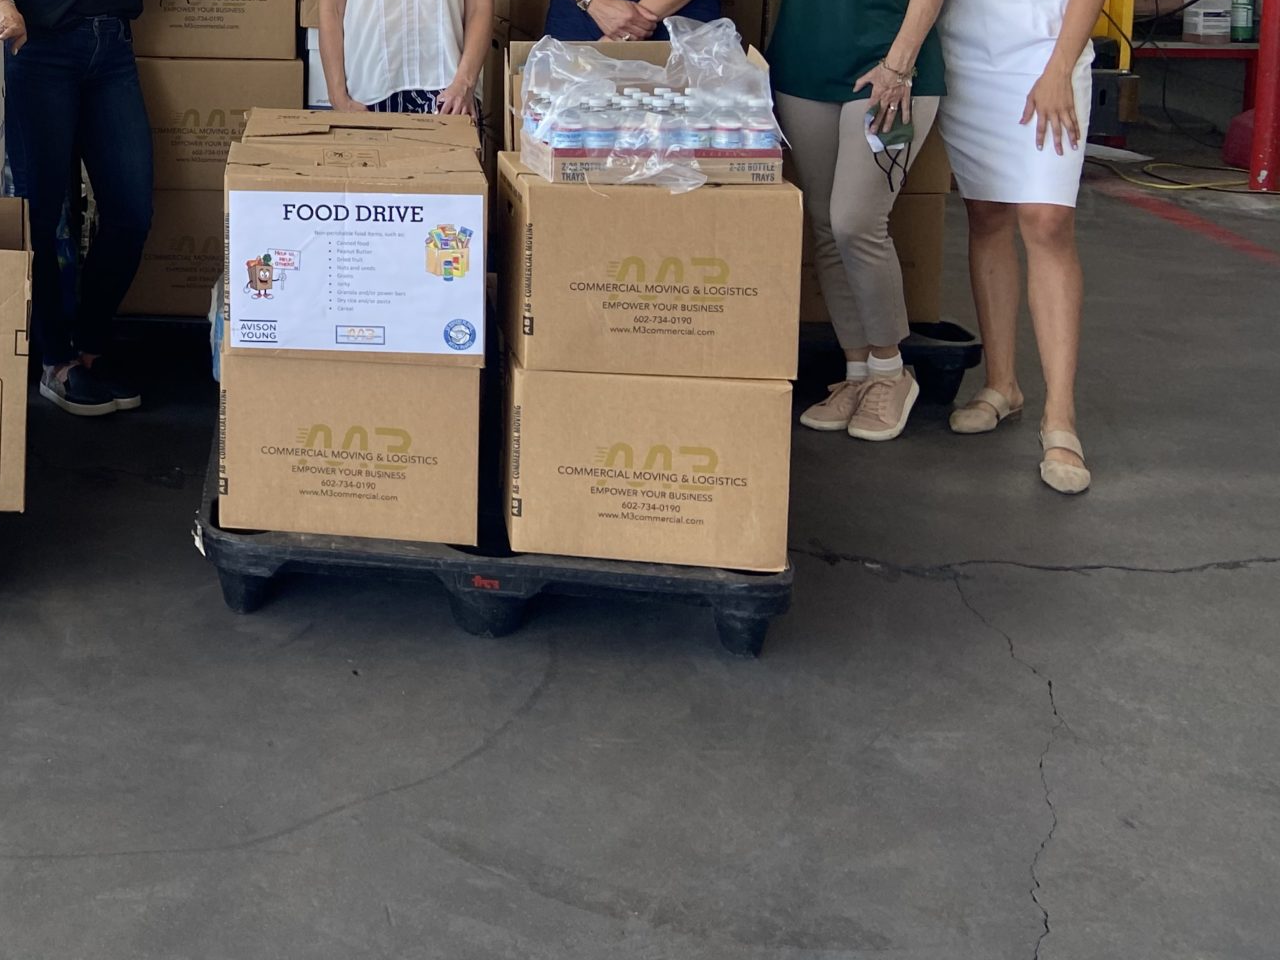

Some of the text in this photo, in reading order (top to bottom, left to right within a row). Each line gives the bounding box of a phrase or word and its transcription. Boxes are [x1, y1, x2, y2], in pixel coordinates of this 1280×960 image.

[748, 162, 775, 172] BOTTLE
[751, 173, 775, 182] TRAYS
[283, 204, 424, 223] FOOD DRIVE
[525, 222, 533, 251] MOVING
[524, 253, 532, 298] COMMERCIAL
[569, 282, 759, 297] COMMERCIAL MOVING & LOGISTICS
[602, 301, 724, 313] EMPOWER YOUR BUSINESS
[633, 315, 692, 325] 602-734-0190
[241, 323, 277, 331] AVISON
[610, 326, 715, 336] www.M3commercial.com
[241, 331, 277, 339] YOUNG
[261, 445, 438, 465] COMMERCIAL MOVING & LOGISTICS
[292, 465, 406, 480] EMPOWER YOUR BUSINESS
[557, 465, 747, 487] COMMERCIAL MOVING & LOGISTICS
[321, 480, 376, 490] 602-734-0190
[299, 489, 398, 501] www.M3commercial.com
[590, 486, 713, 502] EMPOWER YOUR BUSINESS
[621, 501, 681, 512] 602-734-0190
[598, 511, 704, 525] www.M3commercial.com
